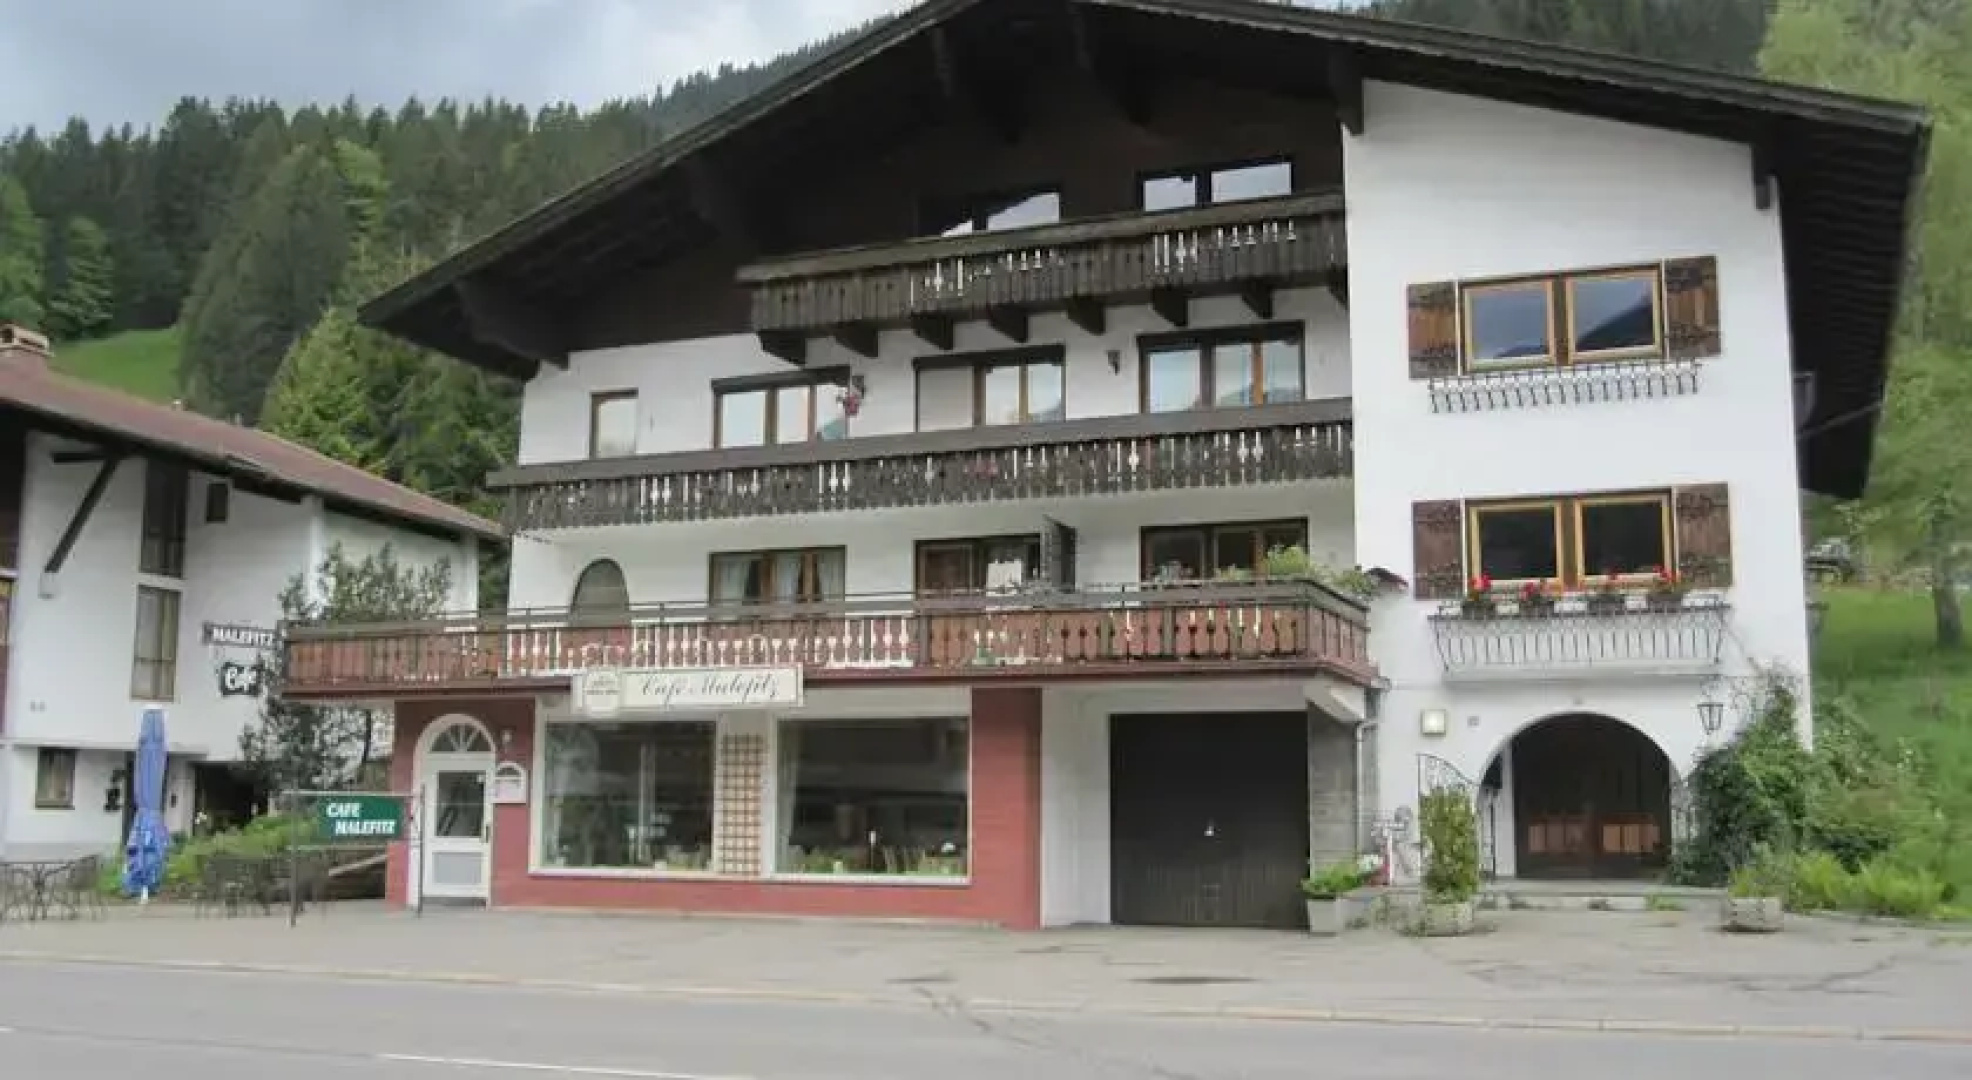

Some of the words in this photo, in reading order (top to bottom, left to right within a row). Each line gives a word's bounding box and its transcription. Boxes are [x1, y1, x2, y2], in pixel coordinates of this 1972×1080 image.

[213, 627, 273, 647] MALEFITZ
[326, 802, 361, 818] CAFE
[335, 819, 396, 835] MALEFITZ
